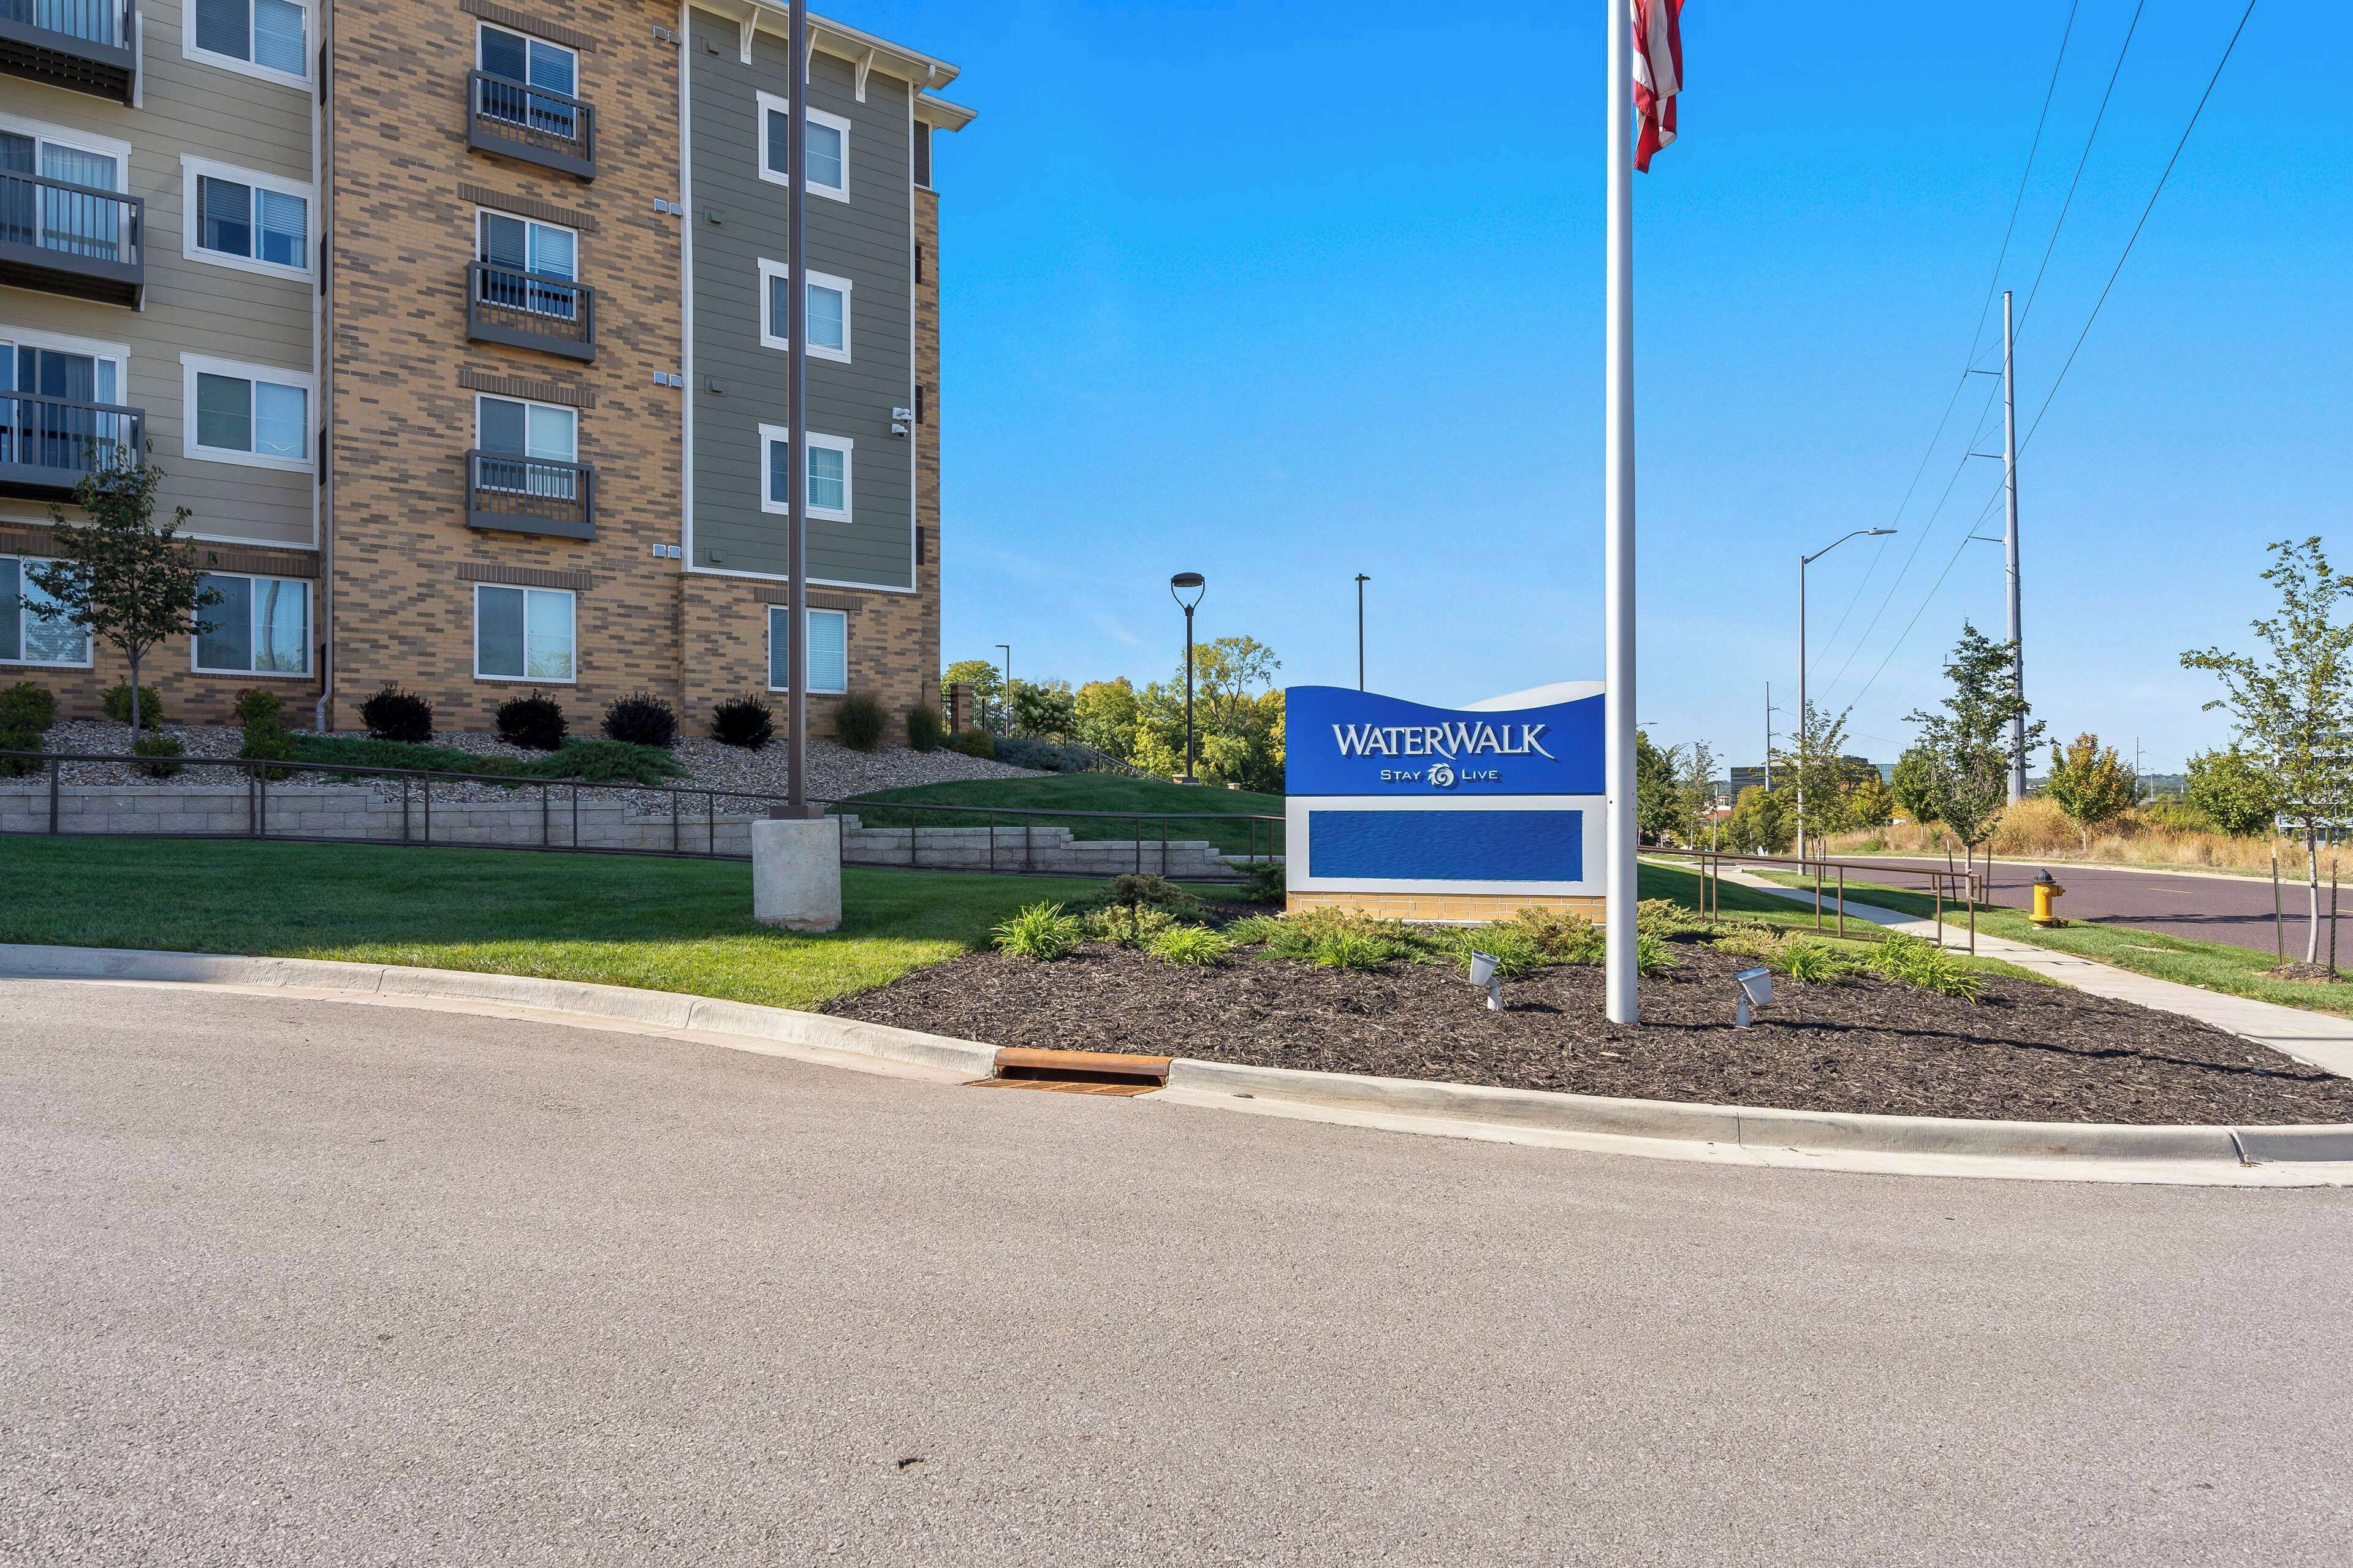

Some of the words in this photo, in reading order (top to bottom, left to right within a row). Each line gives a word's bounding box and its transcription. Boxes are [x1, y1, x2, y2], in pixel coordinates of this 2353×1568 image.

[1332, 722, 1555, 760] WATERWALK
[1380, 770, 1421, 780] STAY
[1462, 769, 1498, 779] LIVE
